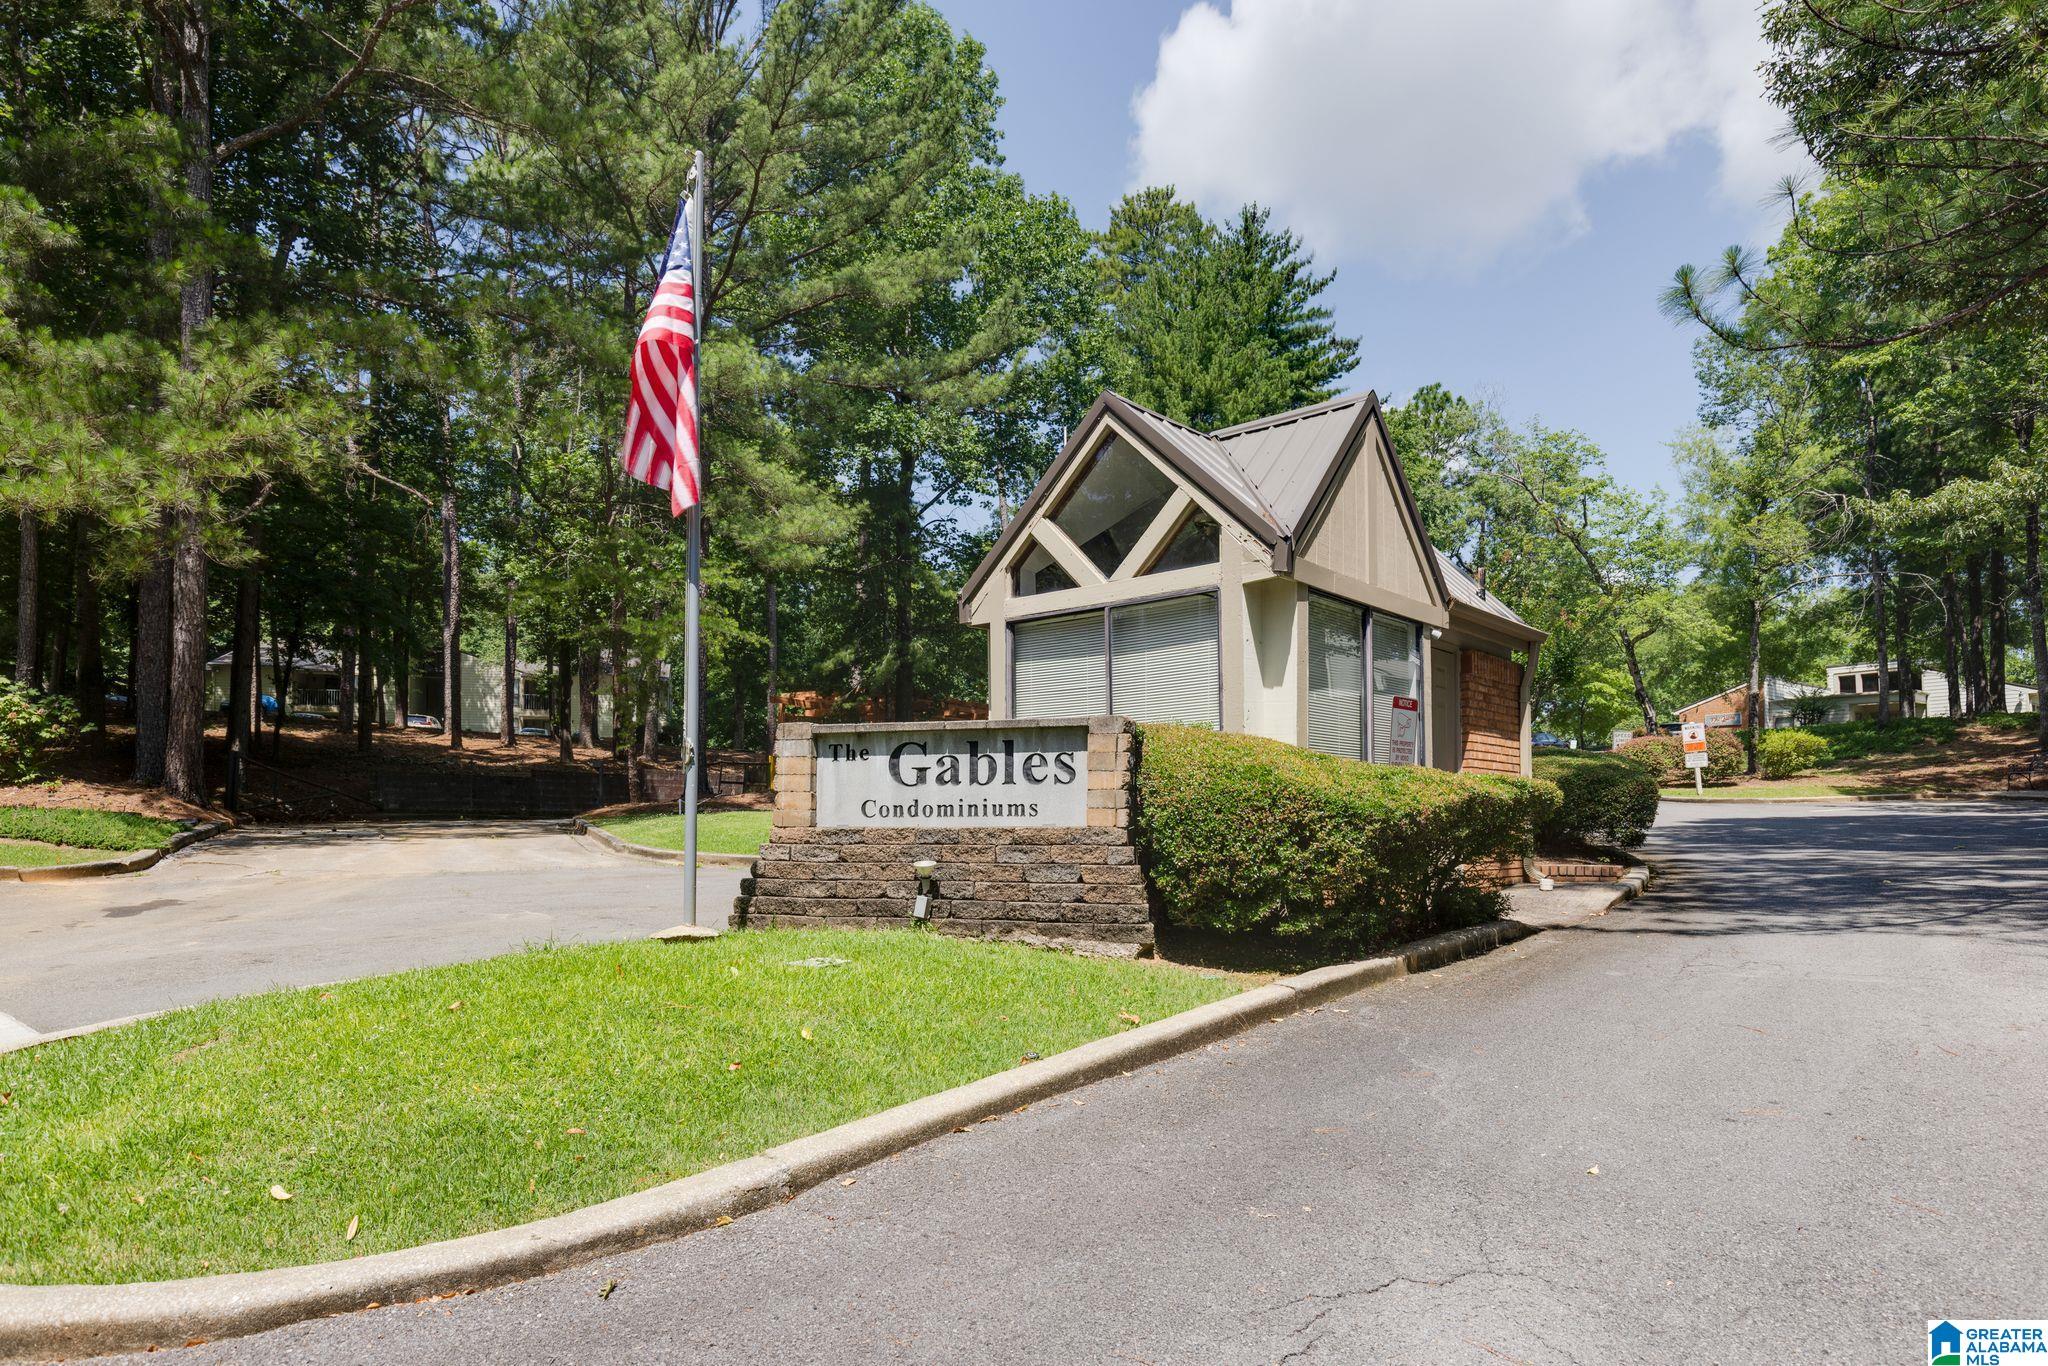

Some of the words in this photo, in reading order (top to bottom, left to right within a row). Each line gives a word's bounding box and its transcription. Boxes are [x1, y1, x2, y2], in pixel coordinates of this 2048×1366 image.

[1399, 698, 1413, 708] NOTICE
[829, 743, 870, 762] The
[888, 739, 1077, 787] Gables
[861, 798, 1039, 819] Condominiums
